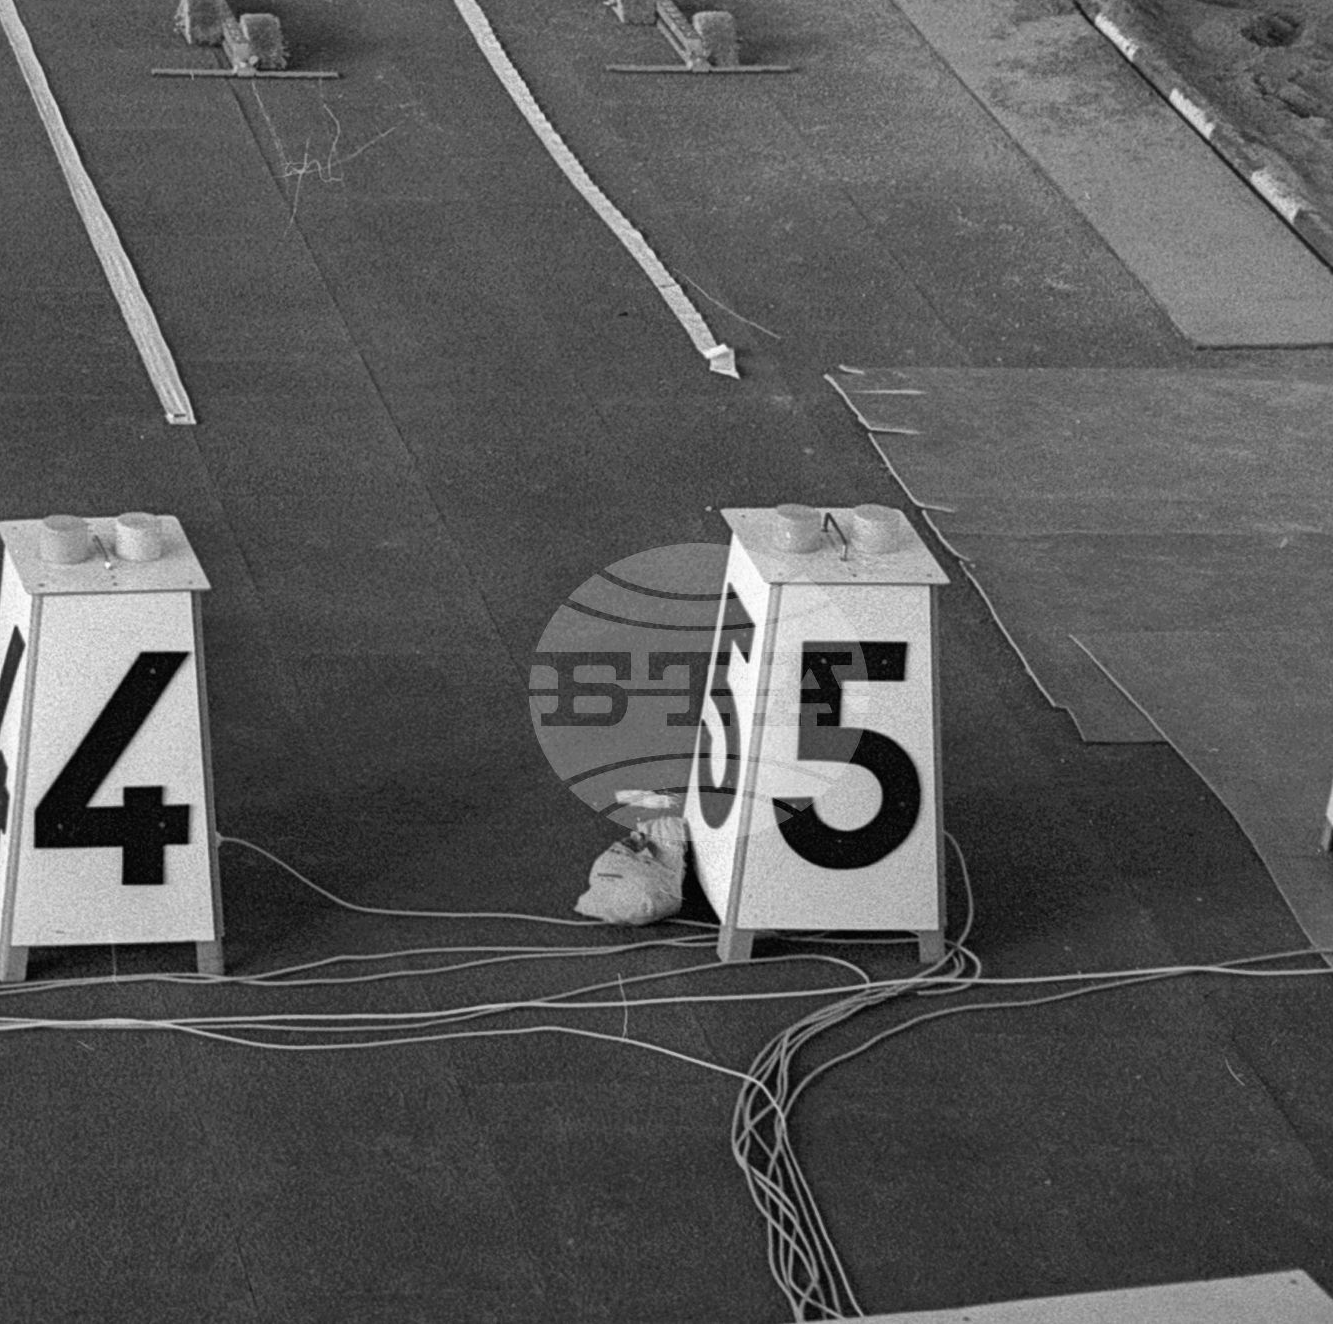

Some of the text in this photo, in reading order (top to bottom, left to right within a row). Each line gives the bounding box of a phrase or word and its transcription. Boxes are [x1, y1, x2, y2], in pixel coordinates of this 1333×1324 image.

[34, 651, 190, 885] 4
[698, 582, 756, 829] 5
[773, 641, 921, 870] 5
